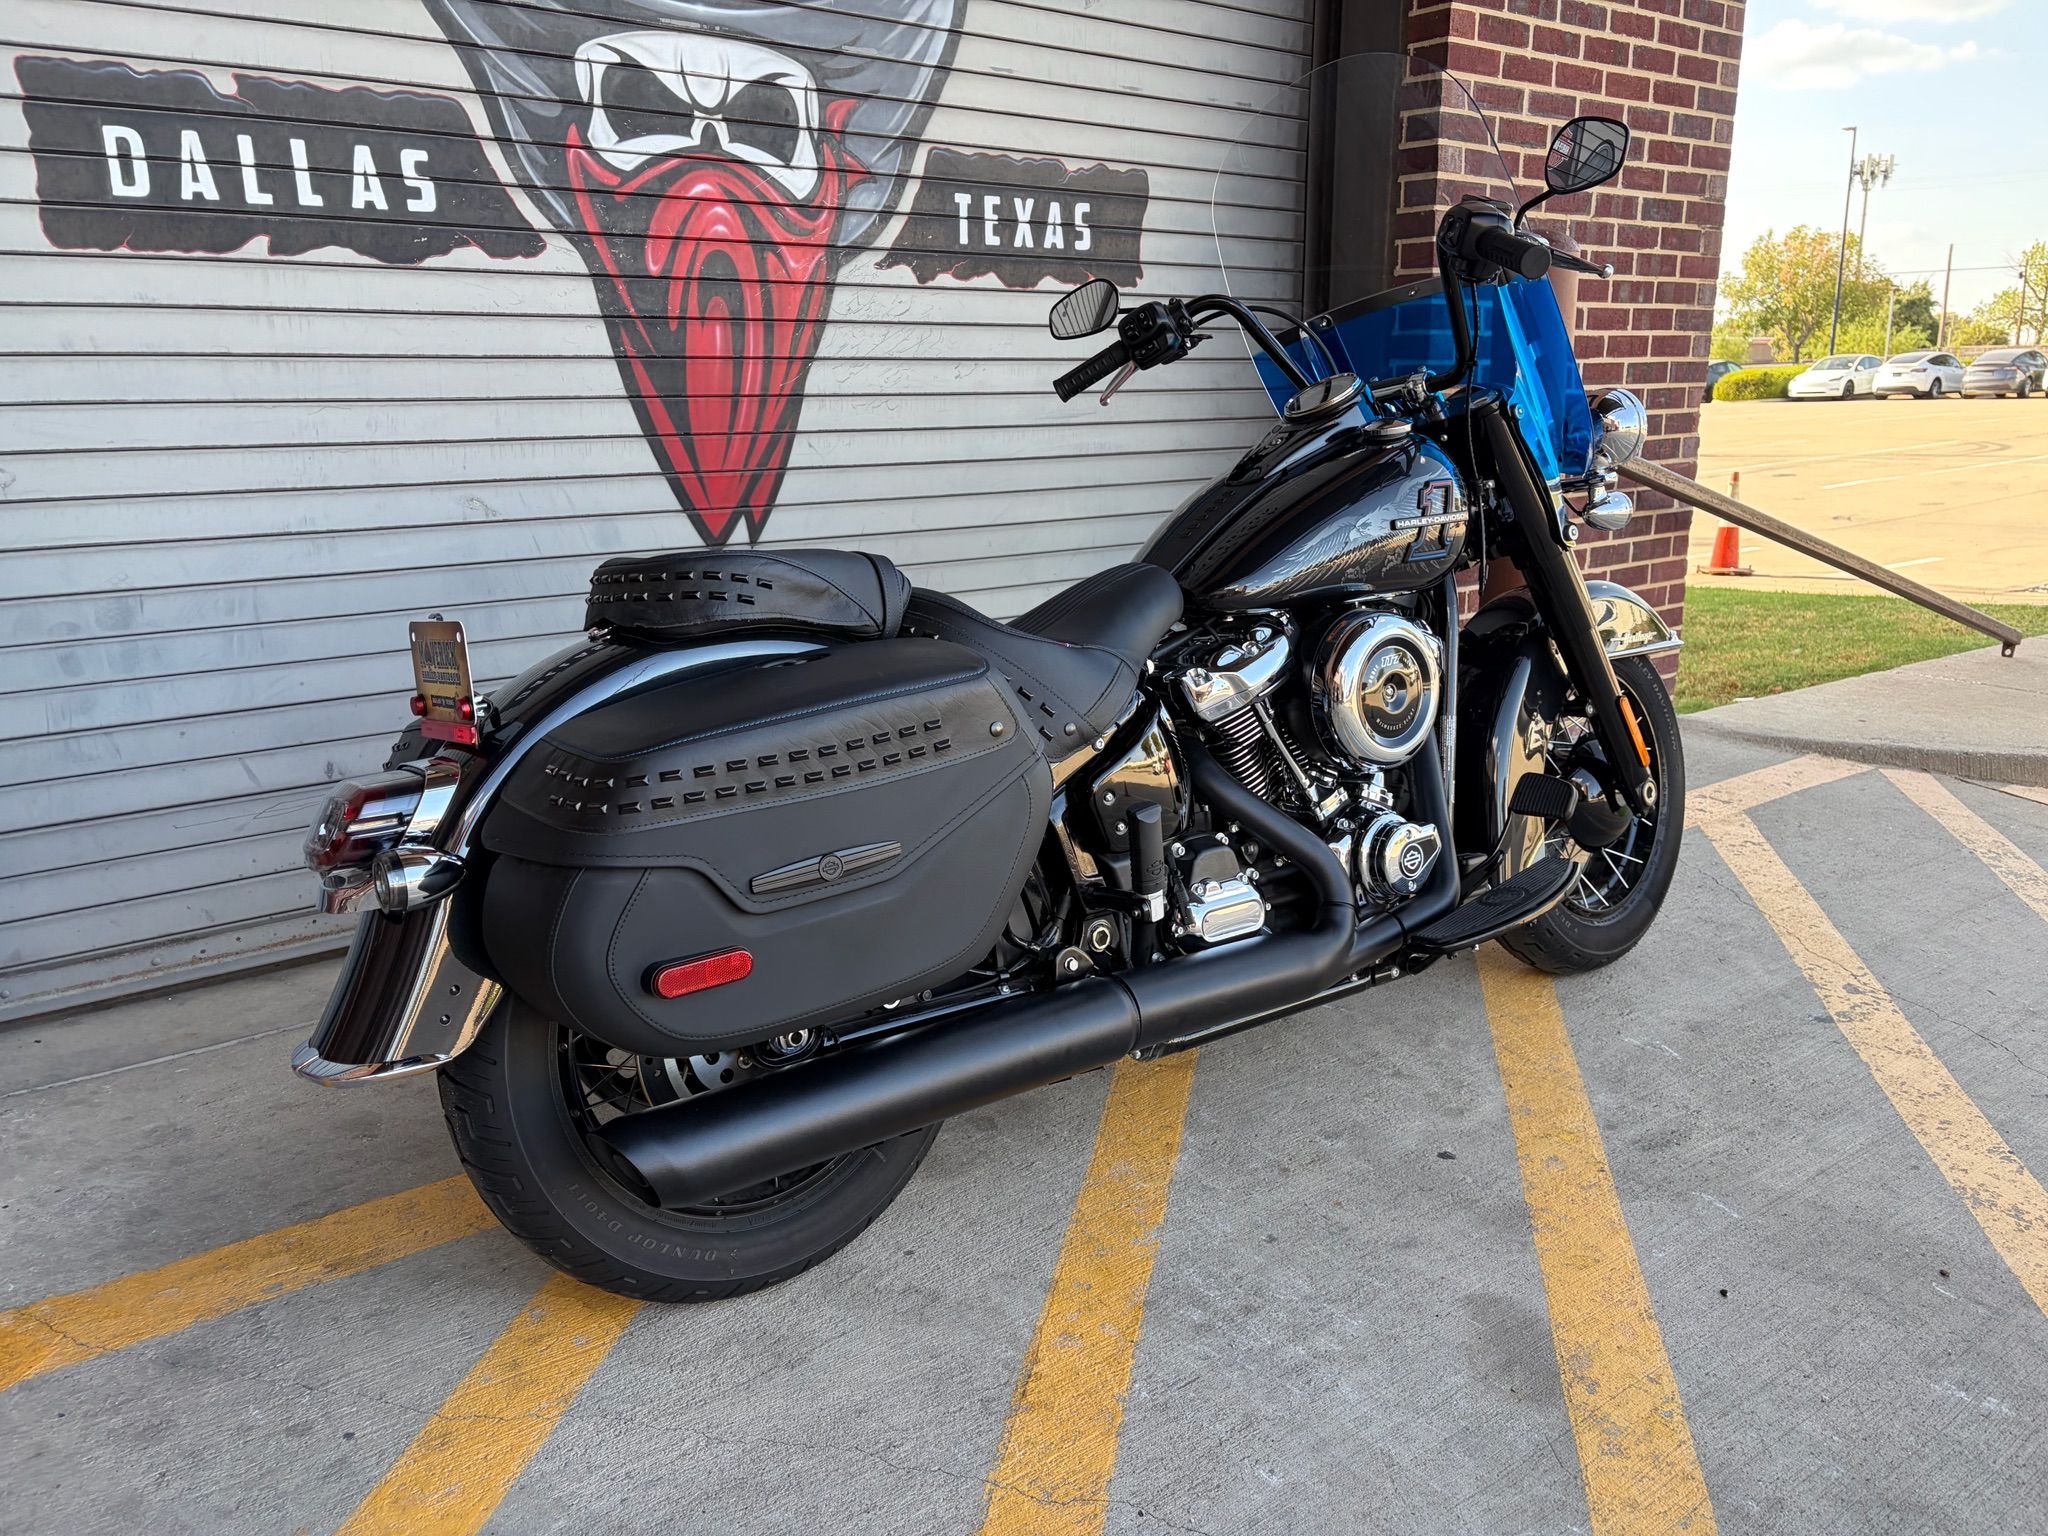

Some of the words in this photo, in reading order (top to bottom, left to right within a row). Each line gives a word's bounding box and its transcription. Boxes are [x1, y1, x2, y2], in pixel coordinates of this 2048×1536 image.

[102, 125, 436, 212] DALLAS
[954, 193, 1091, 250] TEXAS
[1397, 512, 1468, 528] HARLEY-DAVIDSON
[1381, 652, 1402, 668] 117
[566, 1182, 624, 1233] D401T
[627, 1232, 719, 1262] DUNLOP
